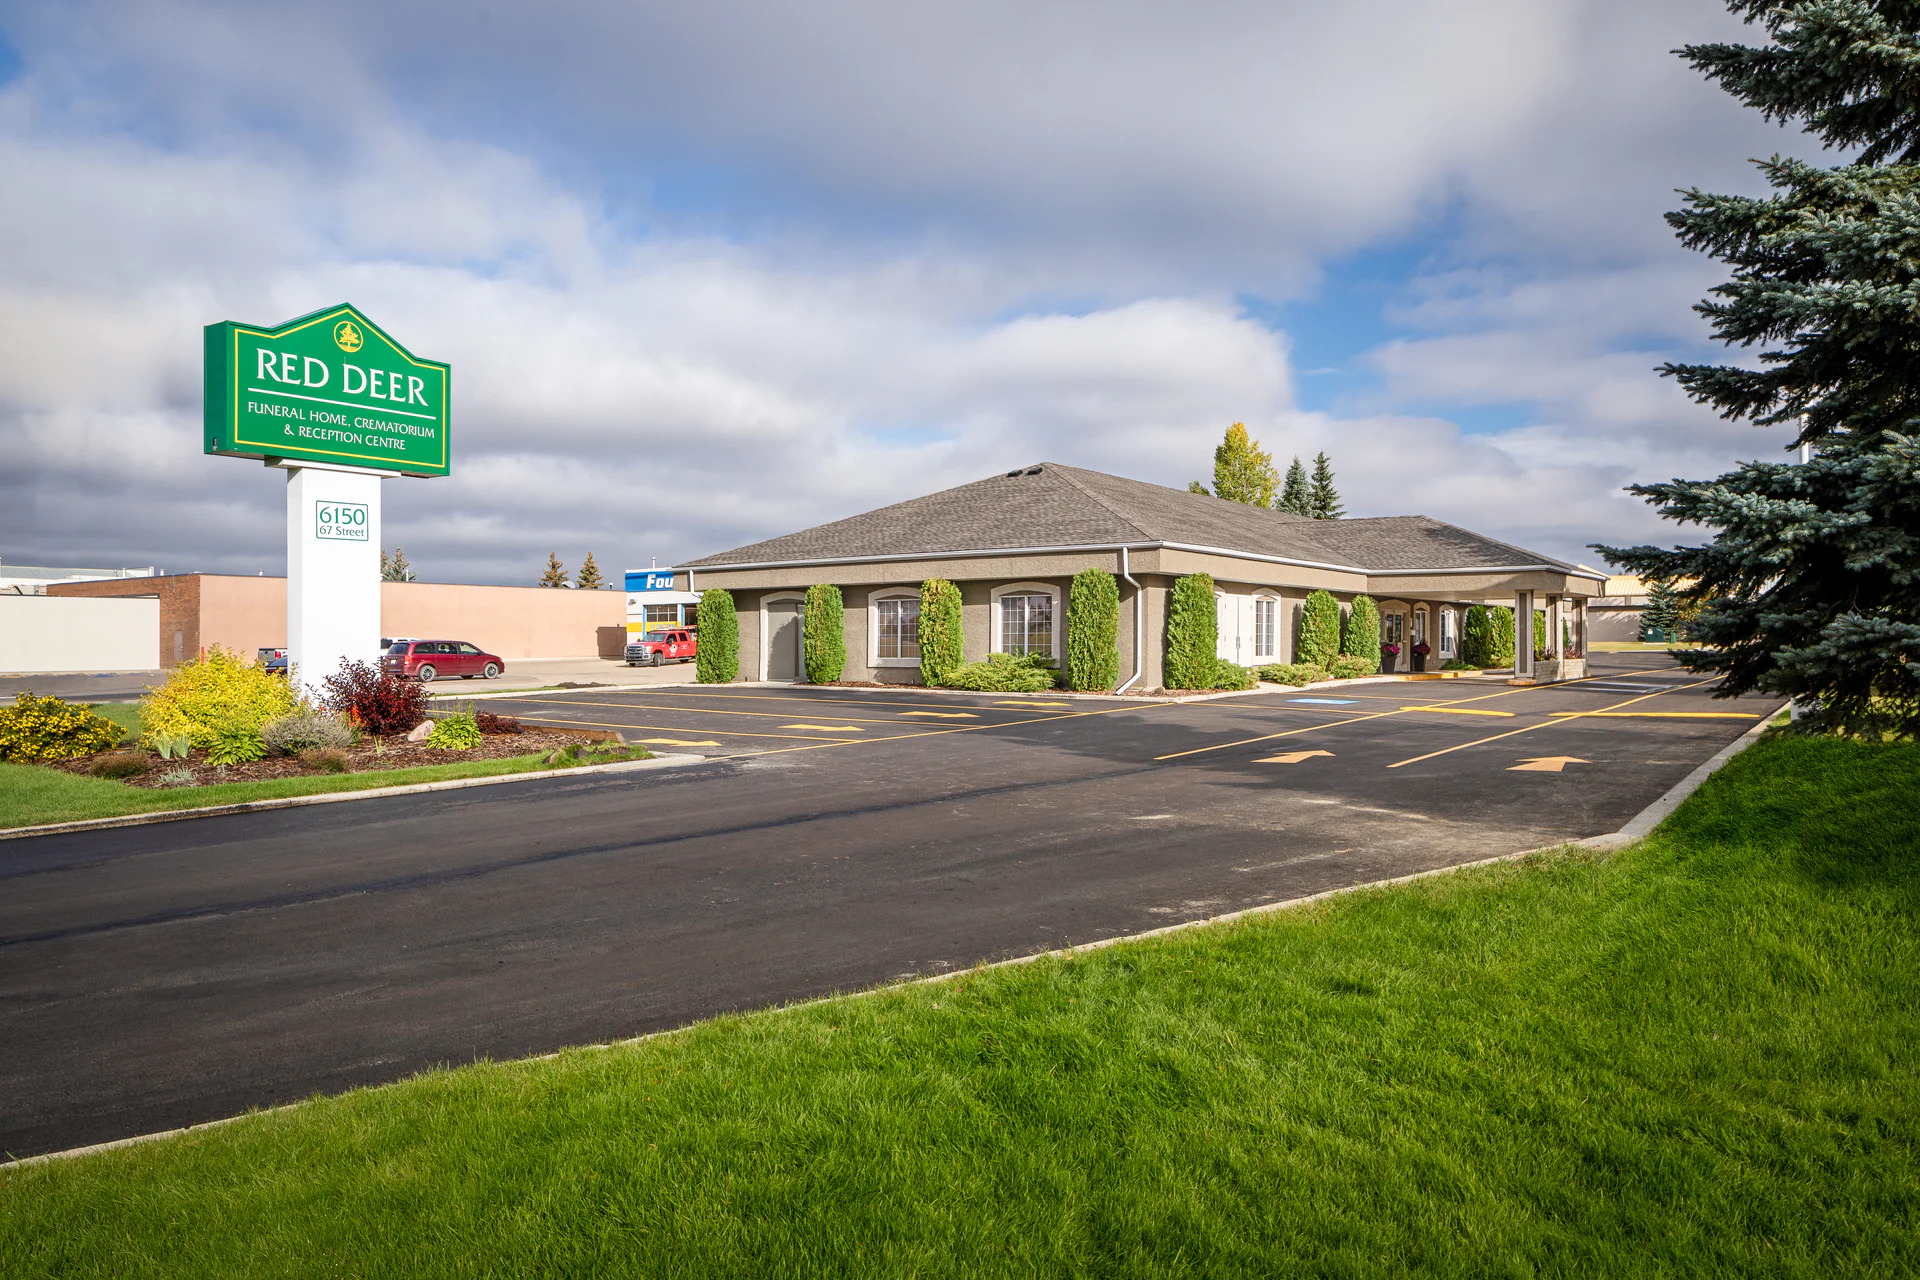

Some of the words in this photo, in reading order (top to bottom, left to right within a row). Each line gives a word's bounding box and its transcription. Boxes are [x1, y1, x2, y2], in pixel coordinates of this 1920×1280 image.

[256, 347, 330, 388] RED
[342, 363, 429, 407] DEER
[247, 401, 306, 420] FUNERAL
[309, 410, 351, 427] HOME,
[354, 417, 435, 438] CREMATORIUM
[284, 423, 295, 436] &
[298, 425, 362, 445] RECEPTION
[365, 435, 406, 450] CENTRE
[319, 506, 365, 526] 6150
[319, 525, 333, 535] 67
[335, 525, 364, 537] Street
